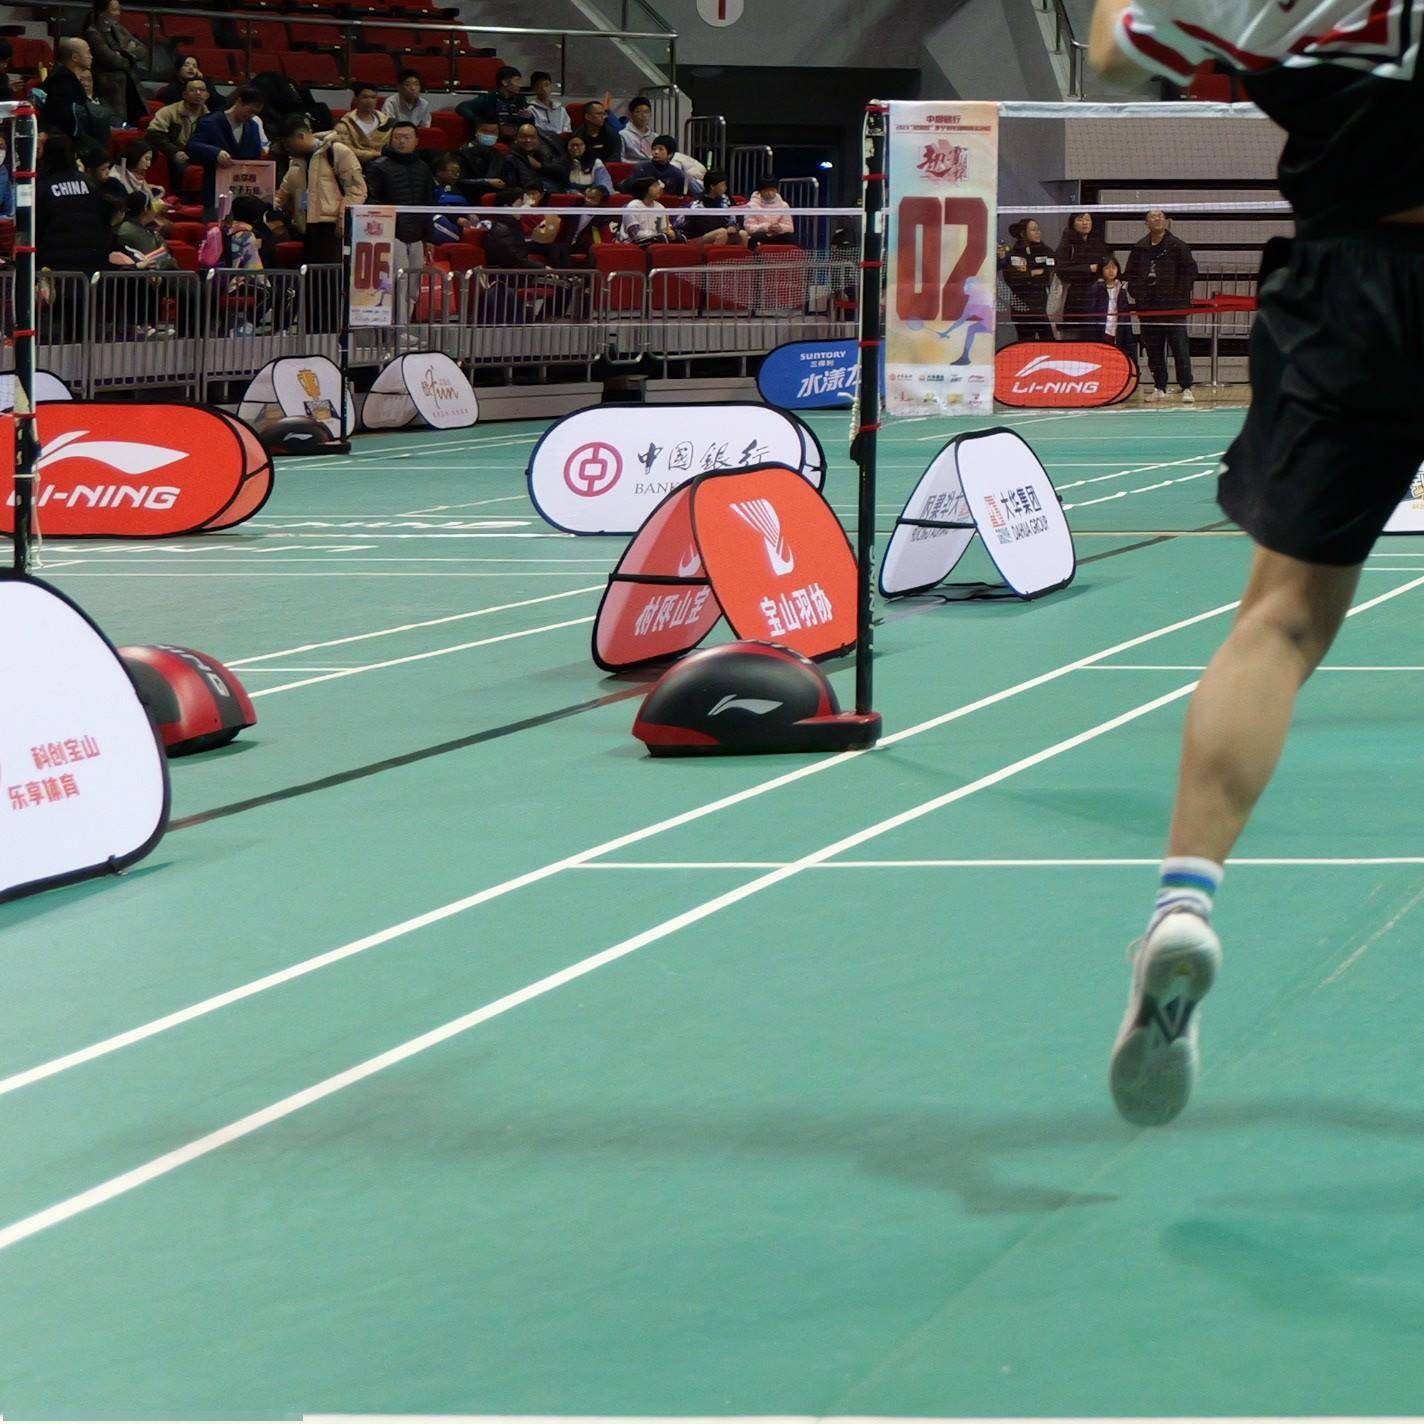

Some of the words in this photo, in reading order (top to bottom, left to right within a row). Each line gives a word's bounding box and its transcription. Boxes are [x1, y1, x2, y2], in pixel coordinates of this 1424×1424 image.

[50, 180, 90, 197] CHINA
[354, 242, 391, 290] 06
[895, 196, 988, 322] 02
[1011, 379, 1100, 394] LI-NING
[1000, 485, 1042, 521] 大华集团
[760, 582, 833, 637] 宝山羽协
[30, 735, 101, 771] 科创宝山
[8, 774, 80, 811] 乐享体育
